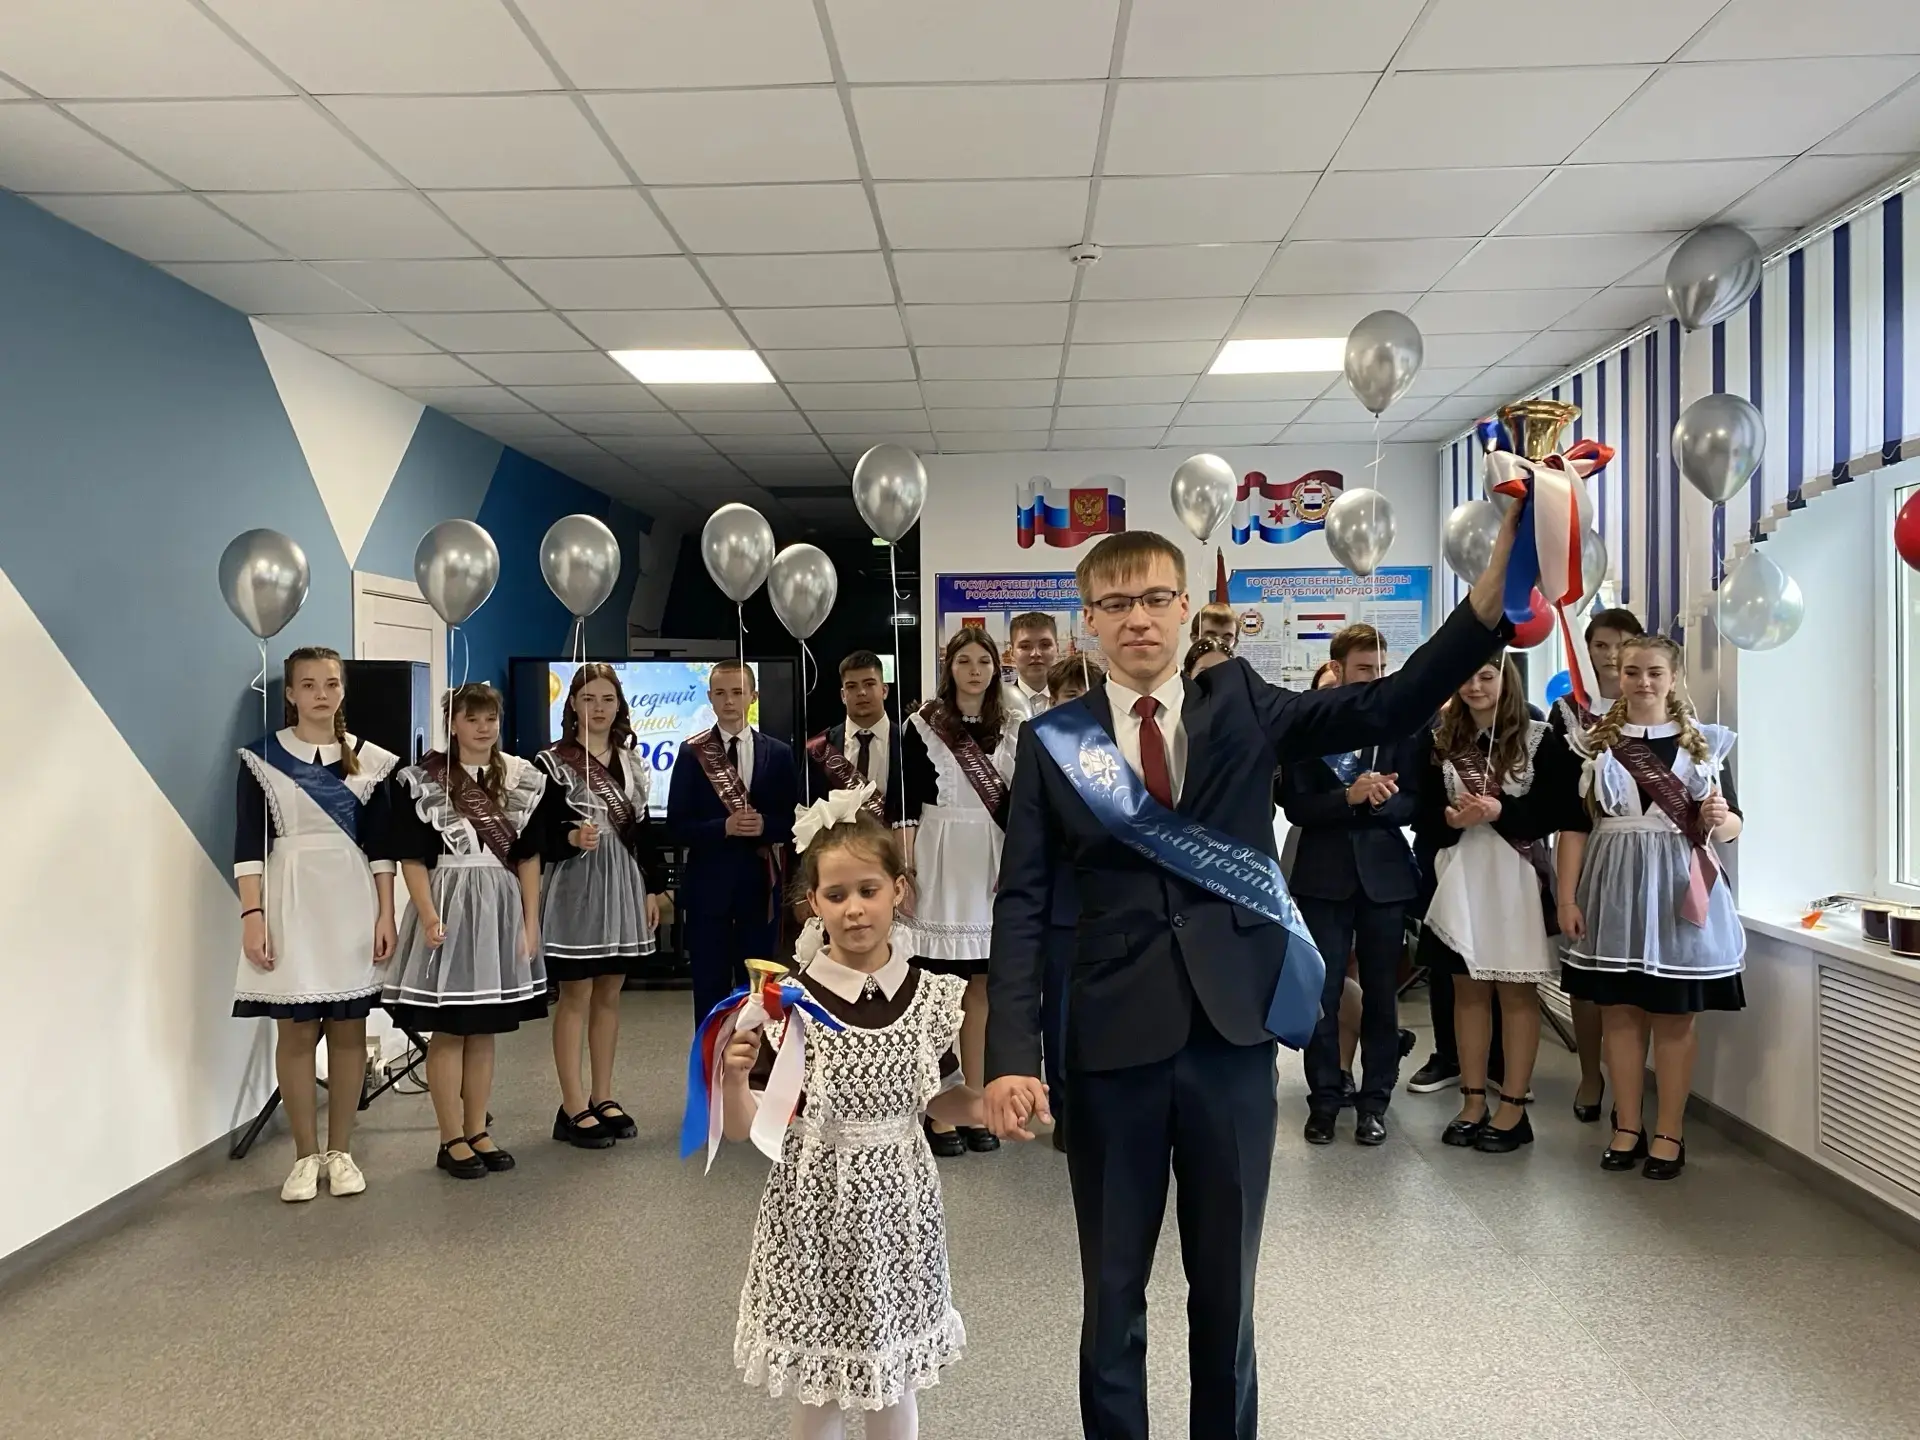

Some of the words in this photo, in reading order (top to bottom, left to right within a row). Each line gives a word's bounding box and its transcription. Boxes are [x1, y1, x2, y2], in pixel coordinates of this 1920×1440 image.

[953, 578, 1058, 591] ГОСУДАРСТВЕННЫЕ
[1246, 576, 1353, 587] ГОСУДАРСТВЕННЫЕ
[1355, 574, 1412, 585] СИМВОЛЫ
[965, 589, 1037, 600] РОССИЙСКОЙ
[1038, 589, 1081, 600] ФЕДЕРА
[1263, 587, 1332, 597] РЕСПУБЛИКИ
[1335, 585, 1396, 596] МОРДОВИЯ
[629, 685, 697, 717] ледний
[702, 742, 745, 809] Выпускни
[1182, 824, 1232, 852] Петров
